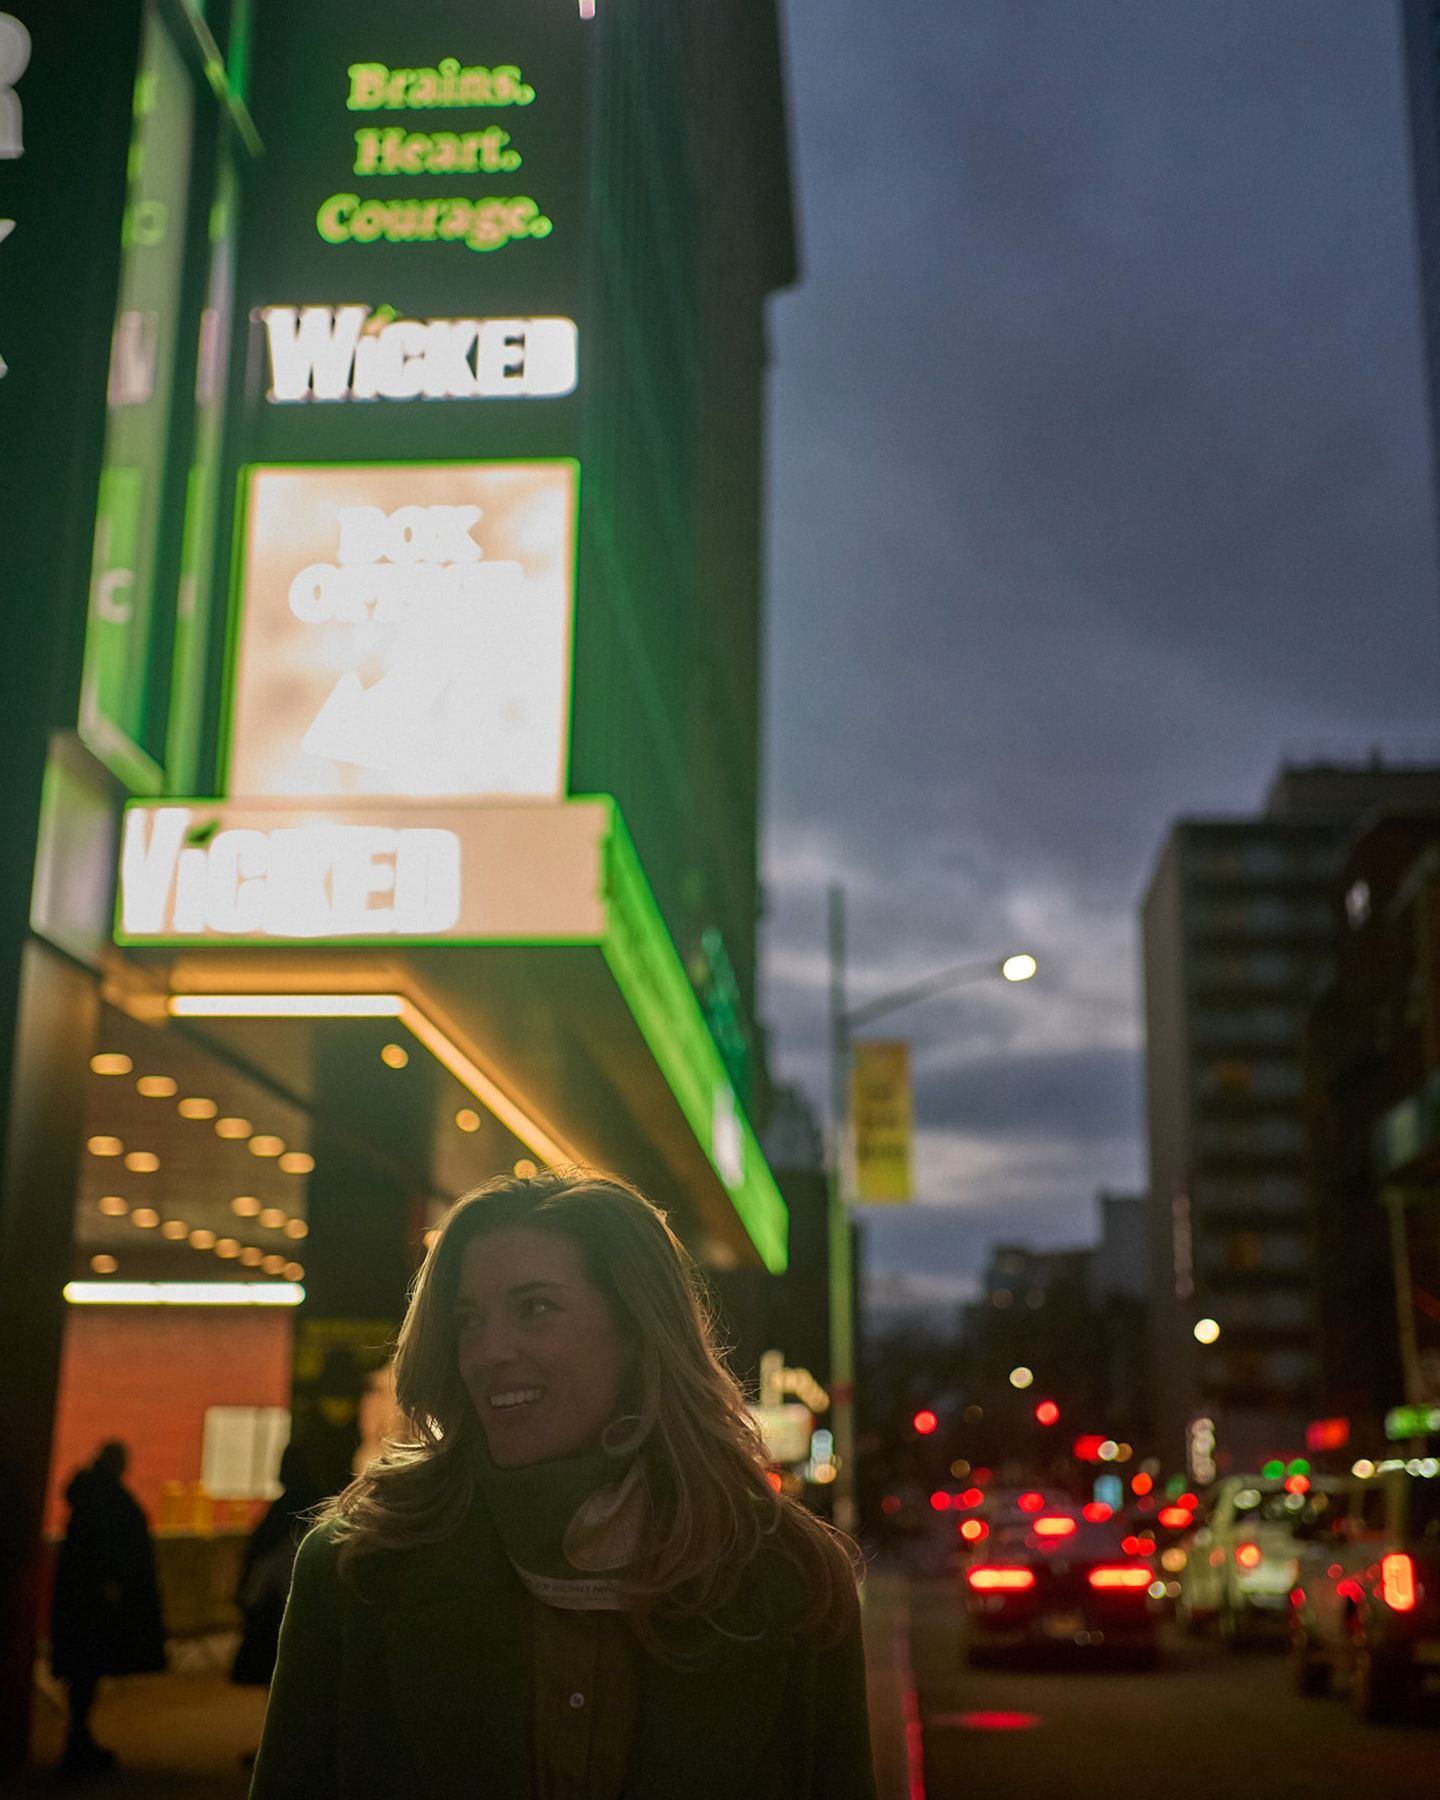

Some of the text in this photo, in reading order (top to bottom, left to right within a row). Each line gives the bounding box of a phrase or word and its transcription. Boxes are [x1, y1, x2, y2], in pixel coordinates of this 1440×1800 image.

[347, 58, 536, 111] Brains.
[353, 125, 522, 176] Heart.
[316, 193, 553, 252] Courage.
